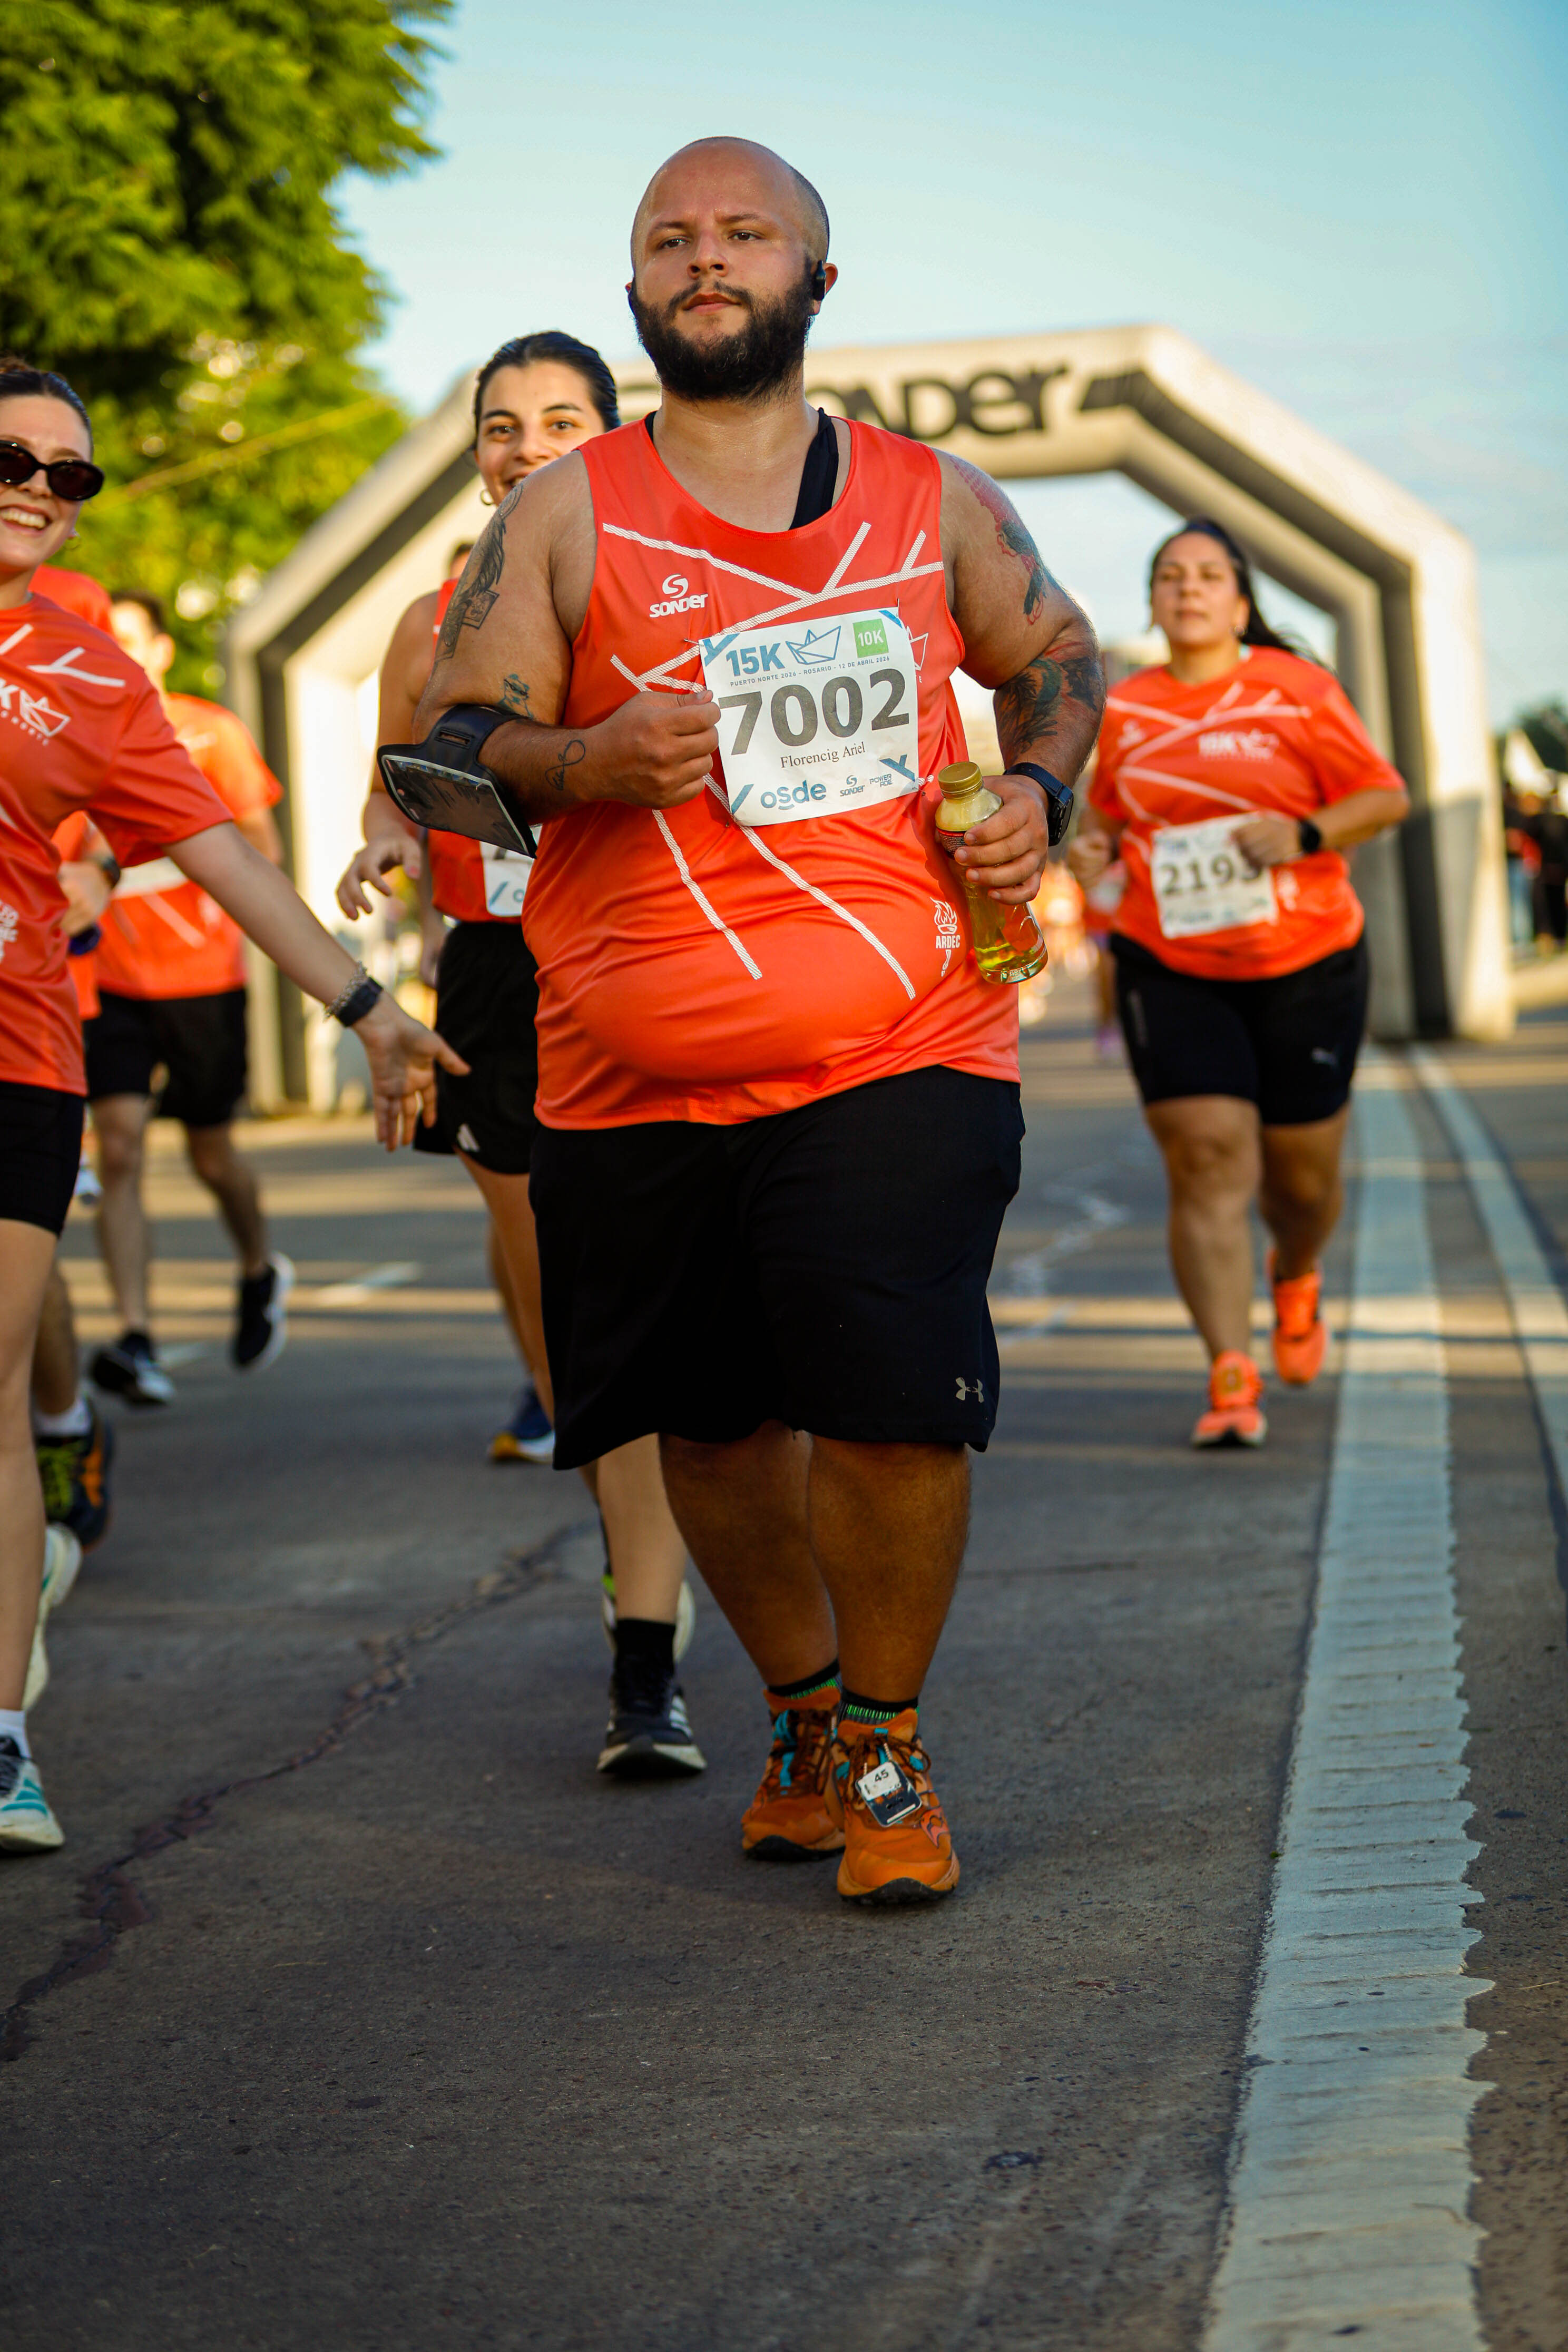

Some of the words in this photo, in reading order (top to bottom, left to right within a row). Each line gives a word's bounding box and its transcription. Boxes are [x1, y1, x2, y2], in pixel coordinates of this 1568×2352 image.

[858, 629, 884, 646] 10K
[726, 642, 786, 677] 15K
[730, 678, 756, 687] PUERTO
[758, 674, 779, 683] NORTE
[803, 665, 832, 674] ROSARIO
[718, 668, 910, 756] 7002
[780, 749, 839, 768] Florencig
[842, 741, 866, 758] Ariel
[869, 773, 892, 785] POWER
[760, 779, 827, 810] osde
[935, 935, 961, 949] ARDEC
[875, 1769, 889, 1782] 45
